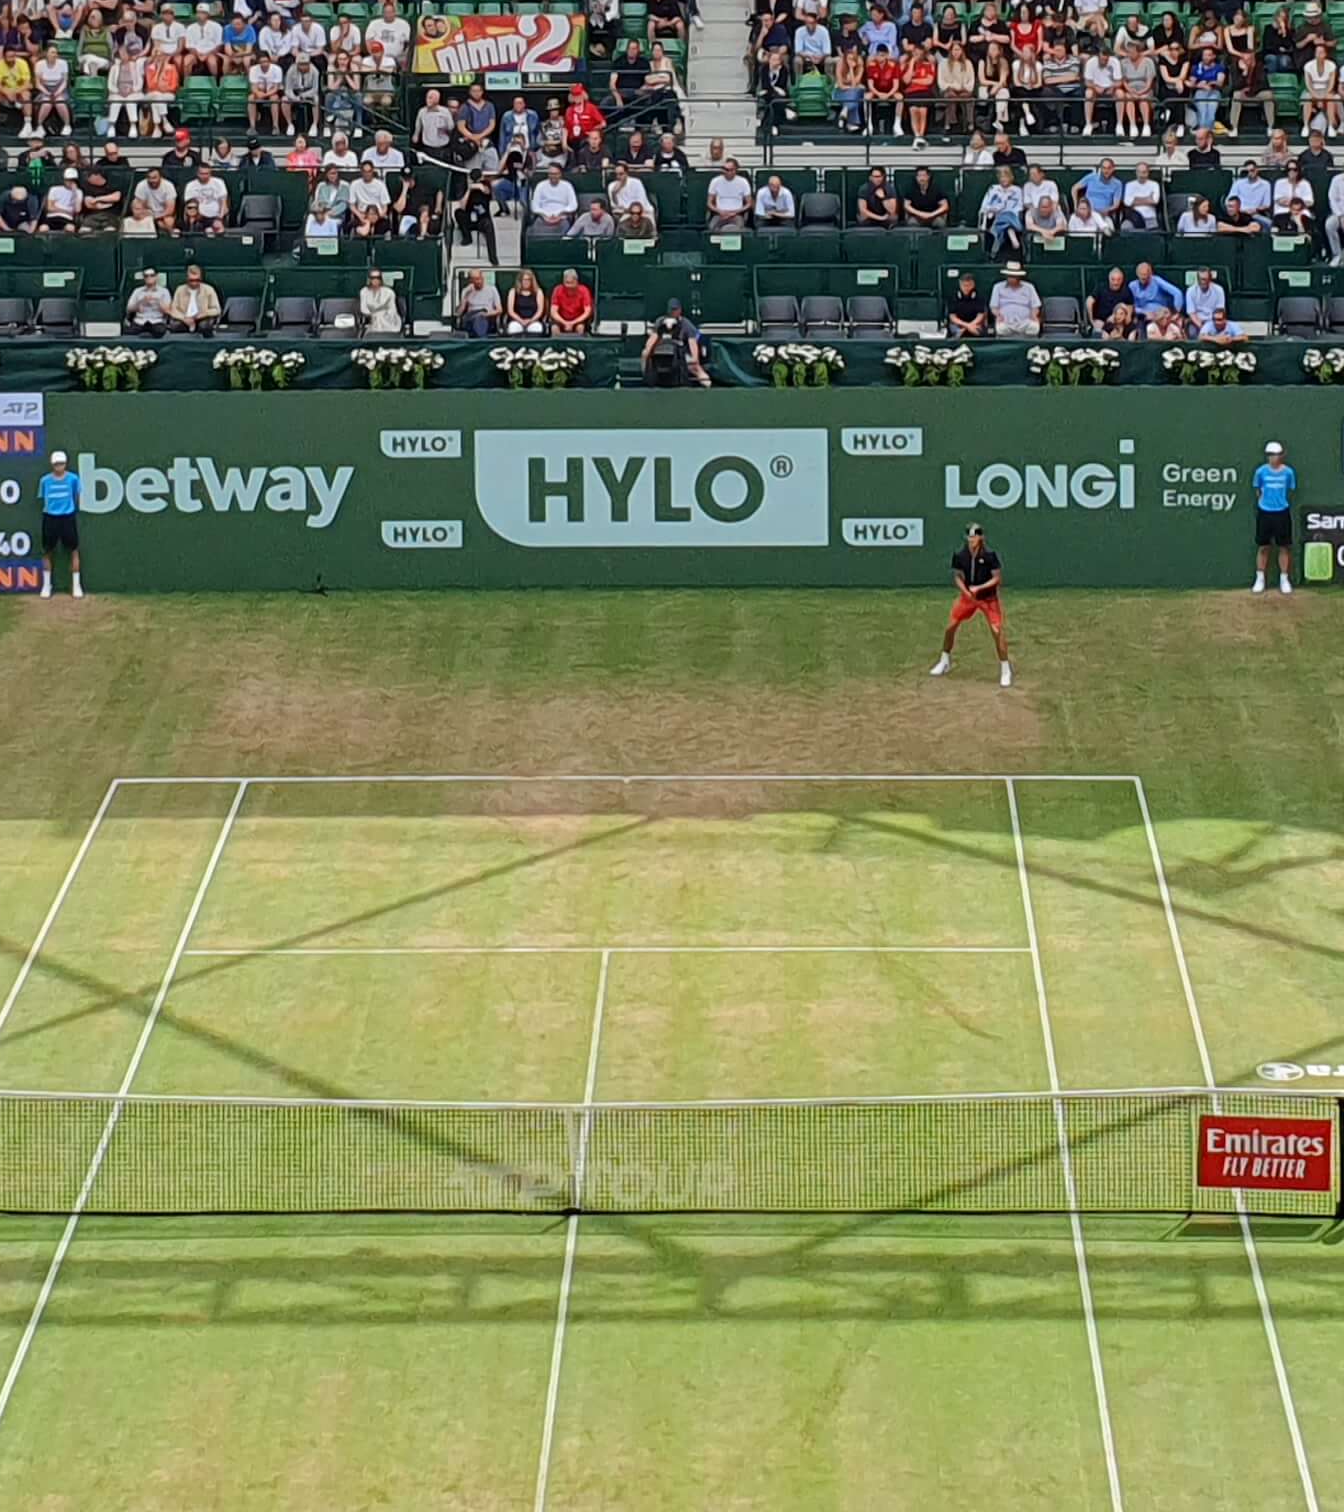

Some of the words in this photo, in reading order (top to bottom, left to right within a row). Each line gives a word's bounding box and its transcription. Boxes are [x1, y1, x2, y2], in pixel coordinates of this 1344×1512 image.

[1162, 465, 1237, 484] Green
[0, 480, 21, 505] 0
[78, 453, 355, 529] betway
[1162, 489, 1236, 512] Energy
[1206, 1128, 1325, 1157] Emirates
[1222, 1157, 1250, 1178] FLY
[1252, 1158, 1307, 1179] BETTER
